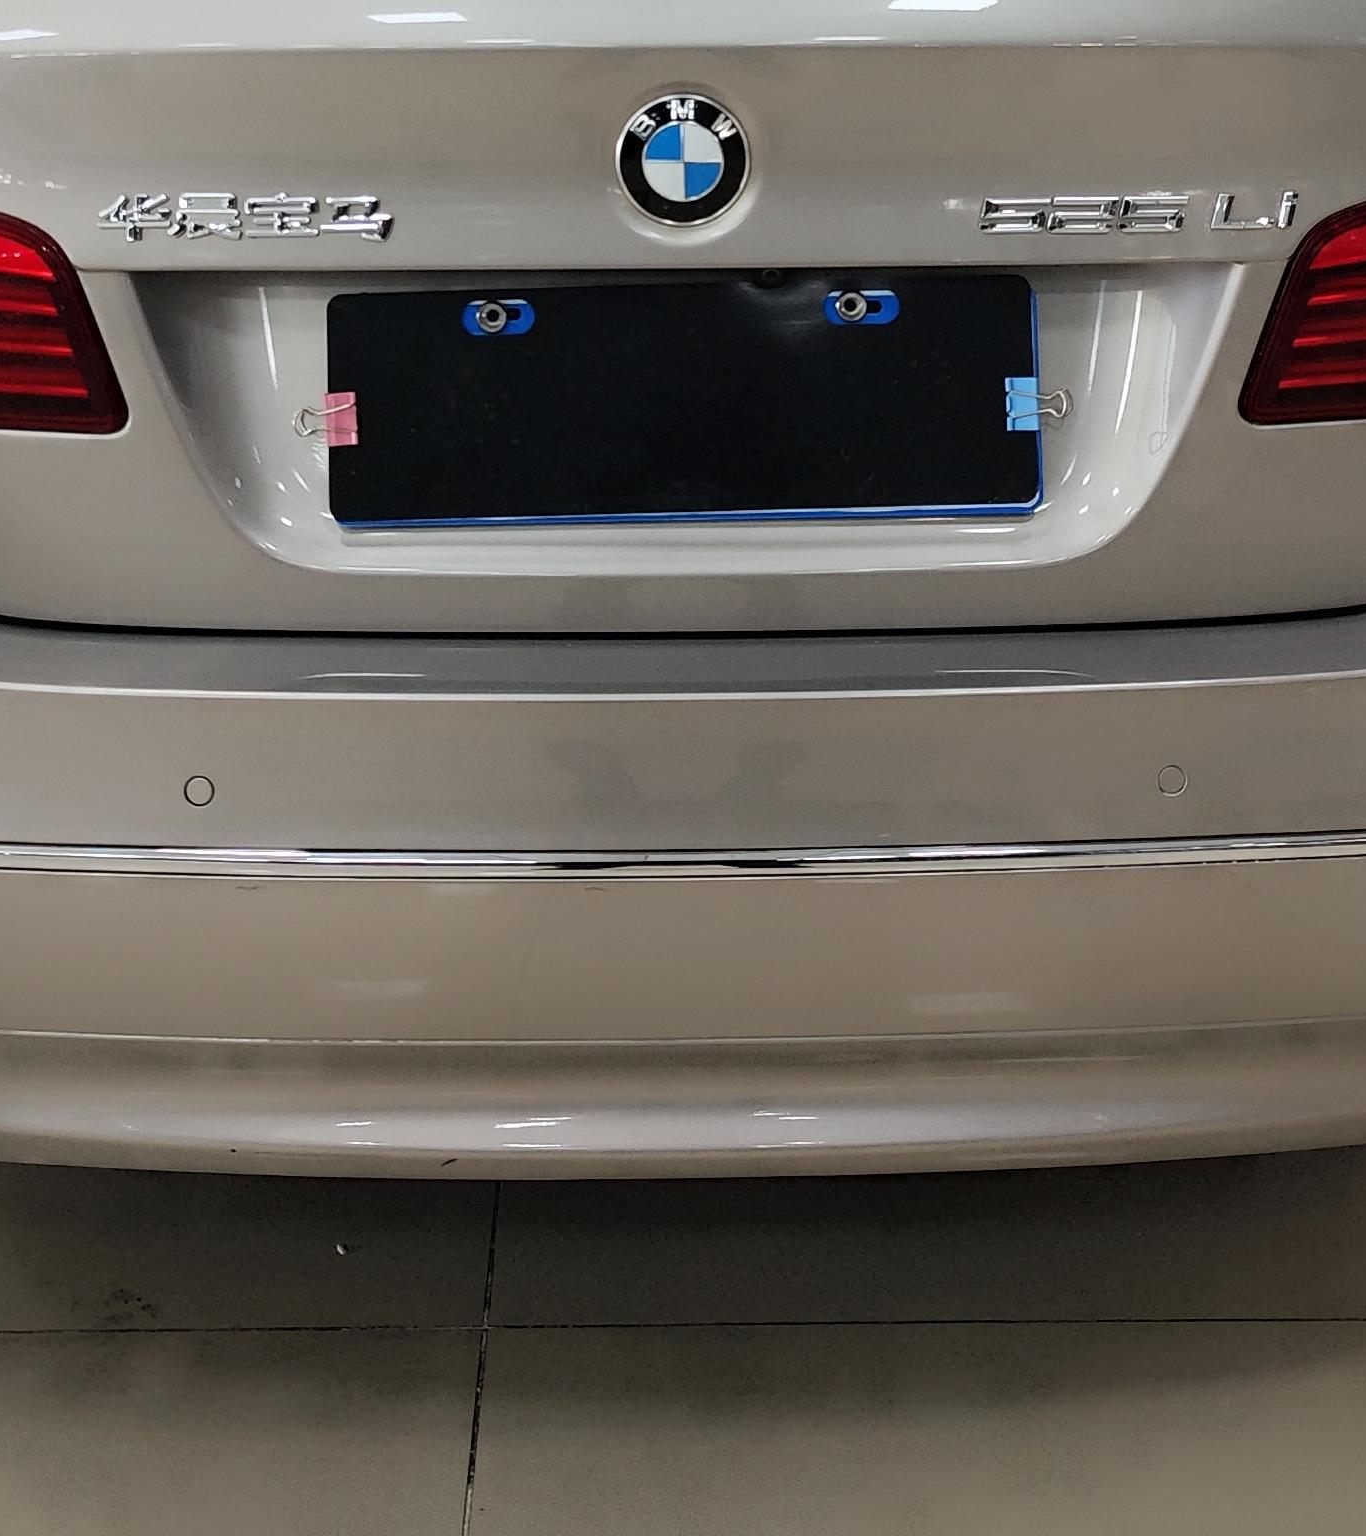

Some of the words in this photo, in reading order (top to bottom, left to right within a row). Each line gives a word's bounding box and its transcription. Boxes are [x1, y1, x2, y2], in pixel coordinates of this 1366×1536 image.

[629, 99, 737, 141] BMW
[97, 192, 392, 242] 华晨宝马
[979, 193, 1189, 234] 525
[1211, 190, 1299, 231] Li
